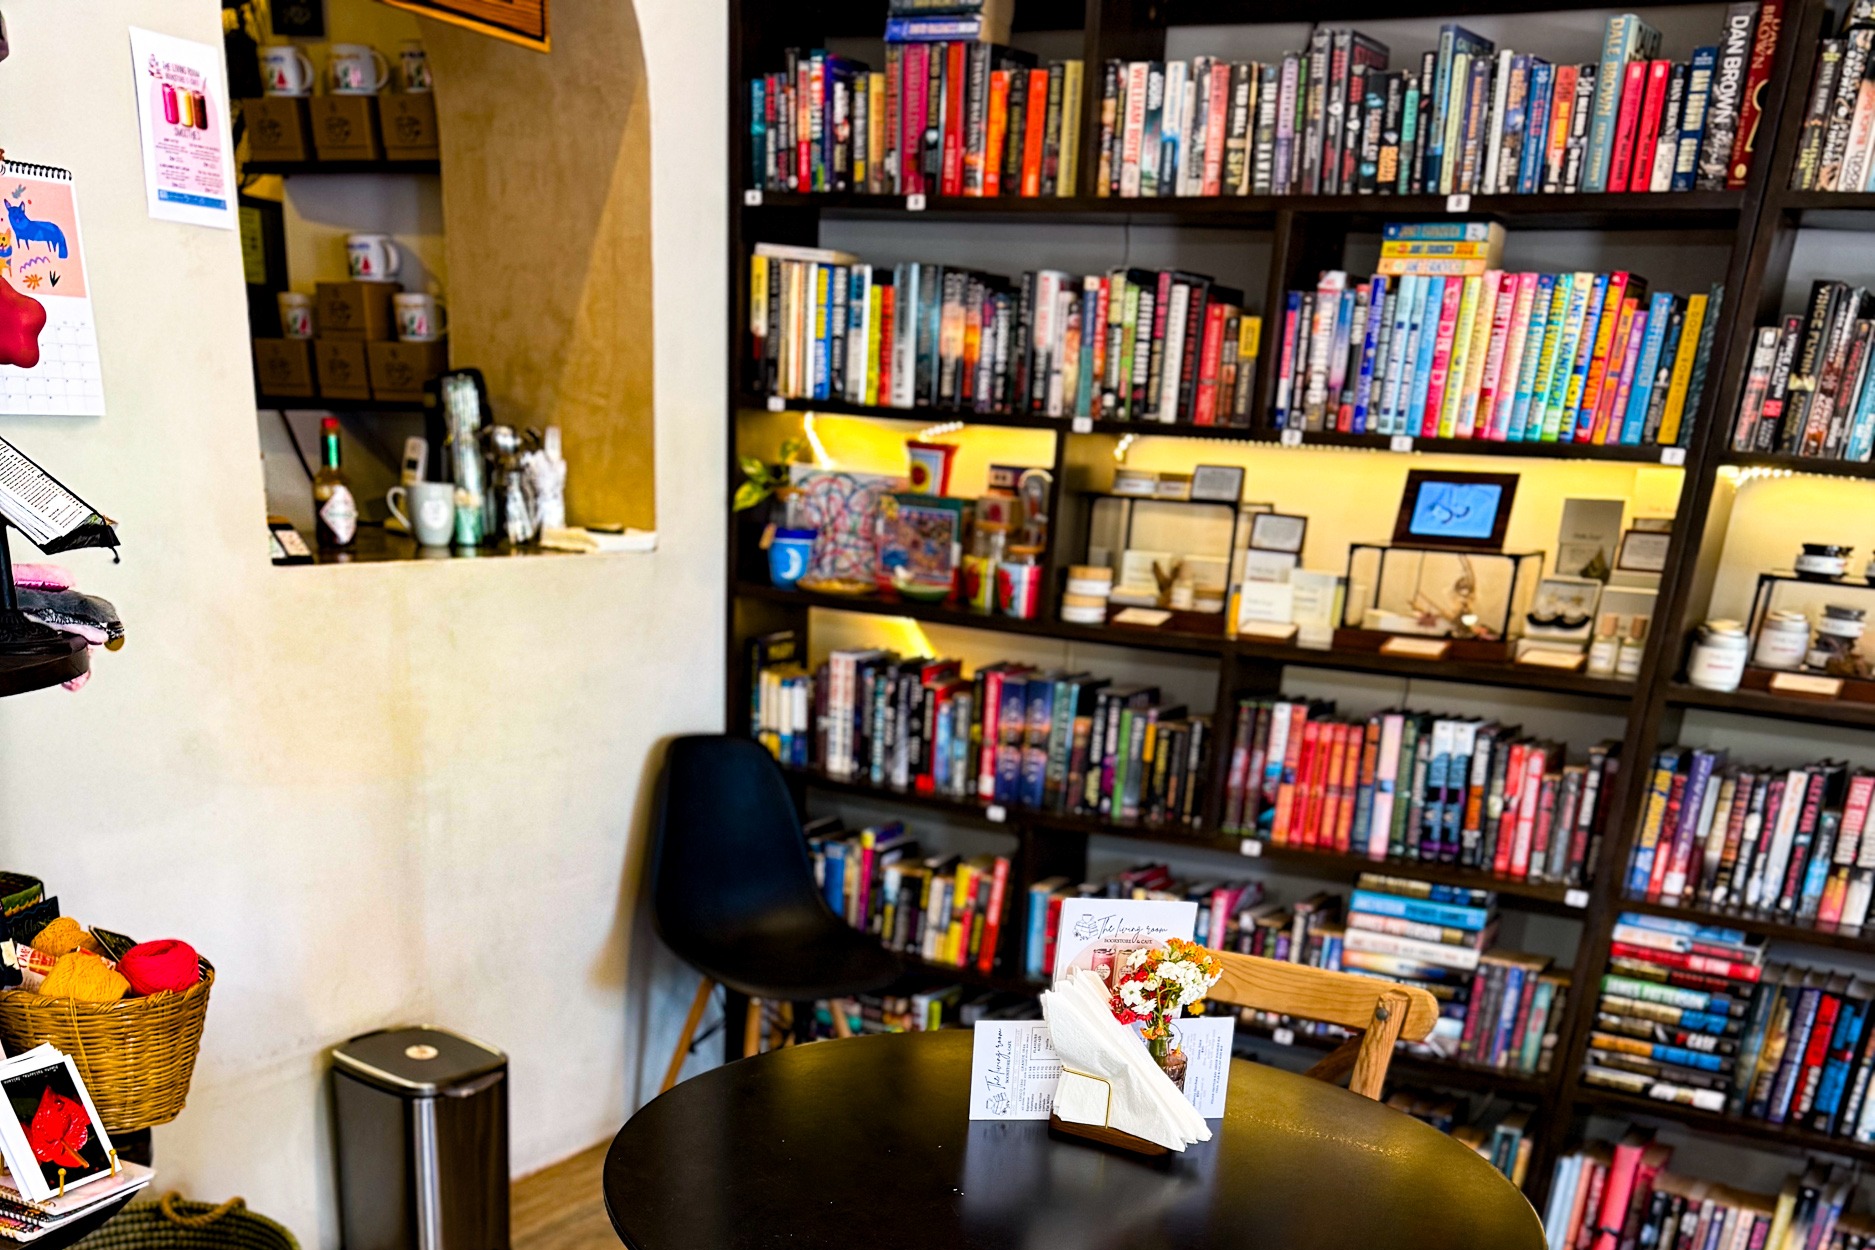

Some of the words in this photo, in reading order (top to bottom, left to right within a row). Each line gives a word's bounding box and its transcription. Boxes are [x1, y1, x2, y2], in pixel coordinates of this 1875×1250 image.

[1608, 18, 1627, 56] DALE
[1726, 15, 1750, 54] DAN
[1752, 5, 1777, 69] BROWN
[1766, 18, 1782, 56] DAN
[1597, 61, 1619, 116] BROWN
[1671, 79, 1685, 100] DAN
[1691, 70, 1712, 92] DAN
[1715, 57, 1743, 123] BROWN
[1838, 50, 1854, 97] BROWN
[1130, 67, 1145, 124] WILLIAM
[1684, 94, 1708, 131] BROWN
[1742, 88, 1754, 117] SECRET
[1233, 107, 1247, 136] BELL
[1666, 102, 1682, 135] BROWN
[1227, 152, 1243, 187] SPY
[1677, 138, 1700, 173] ORIGIN
[1532, 287, 1552, 324] JANET
[1548, 285, 1568, 321] JANET
[1564, 287, 1585, 329] JANET
[1811, 285, 1832, 329] VINCE
[1685, 311, 1699, 343] DOGS
[1534, 325, 1560, 393] EVANOVICH
[1782, 333, 1798, 364] VINCE
[1800, 331, 1821, 373] FLYNN
[1550, 332, 1576, 407] EVANOVICH
[1582, 360, 1605, 409] SEVEN
[1773, 365, 1790, 398] FLYNN
[1565, 374, 1582, 409] HOT
[1806, 774, 1825, 803] ALEX
[1098, 914, 1116, 939] The
[1115, 918, 1143, 943] living
[1146, 926, 1168, 935] room
[995, 1028, 1004, 1048] room
[988, 1050, 1010, 1074] living
[985, 1075, 1006, 1091] The
